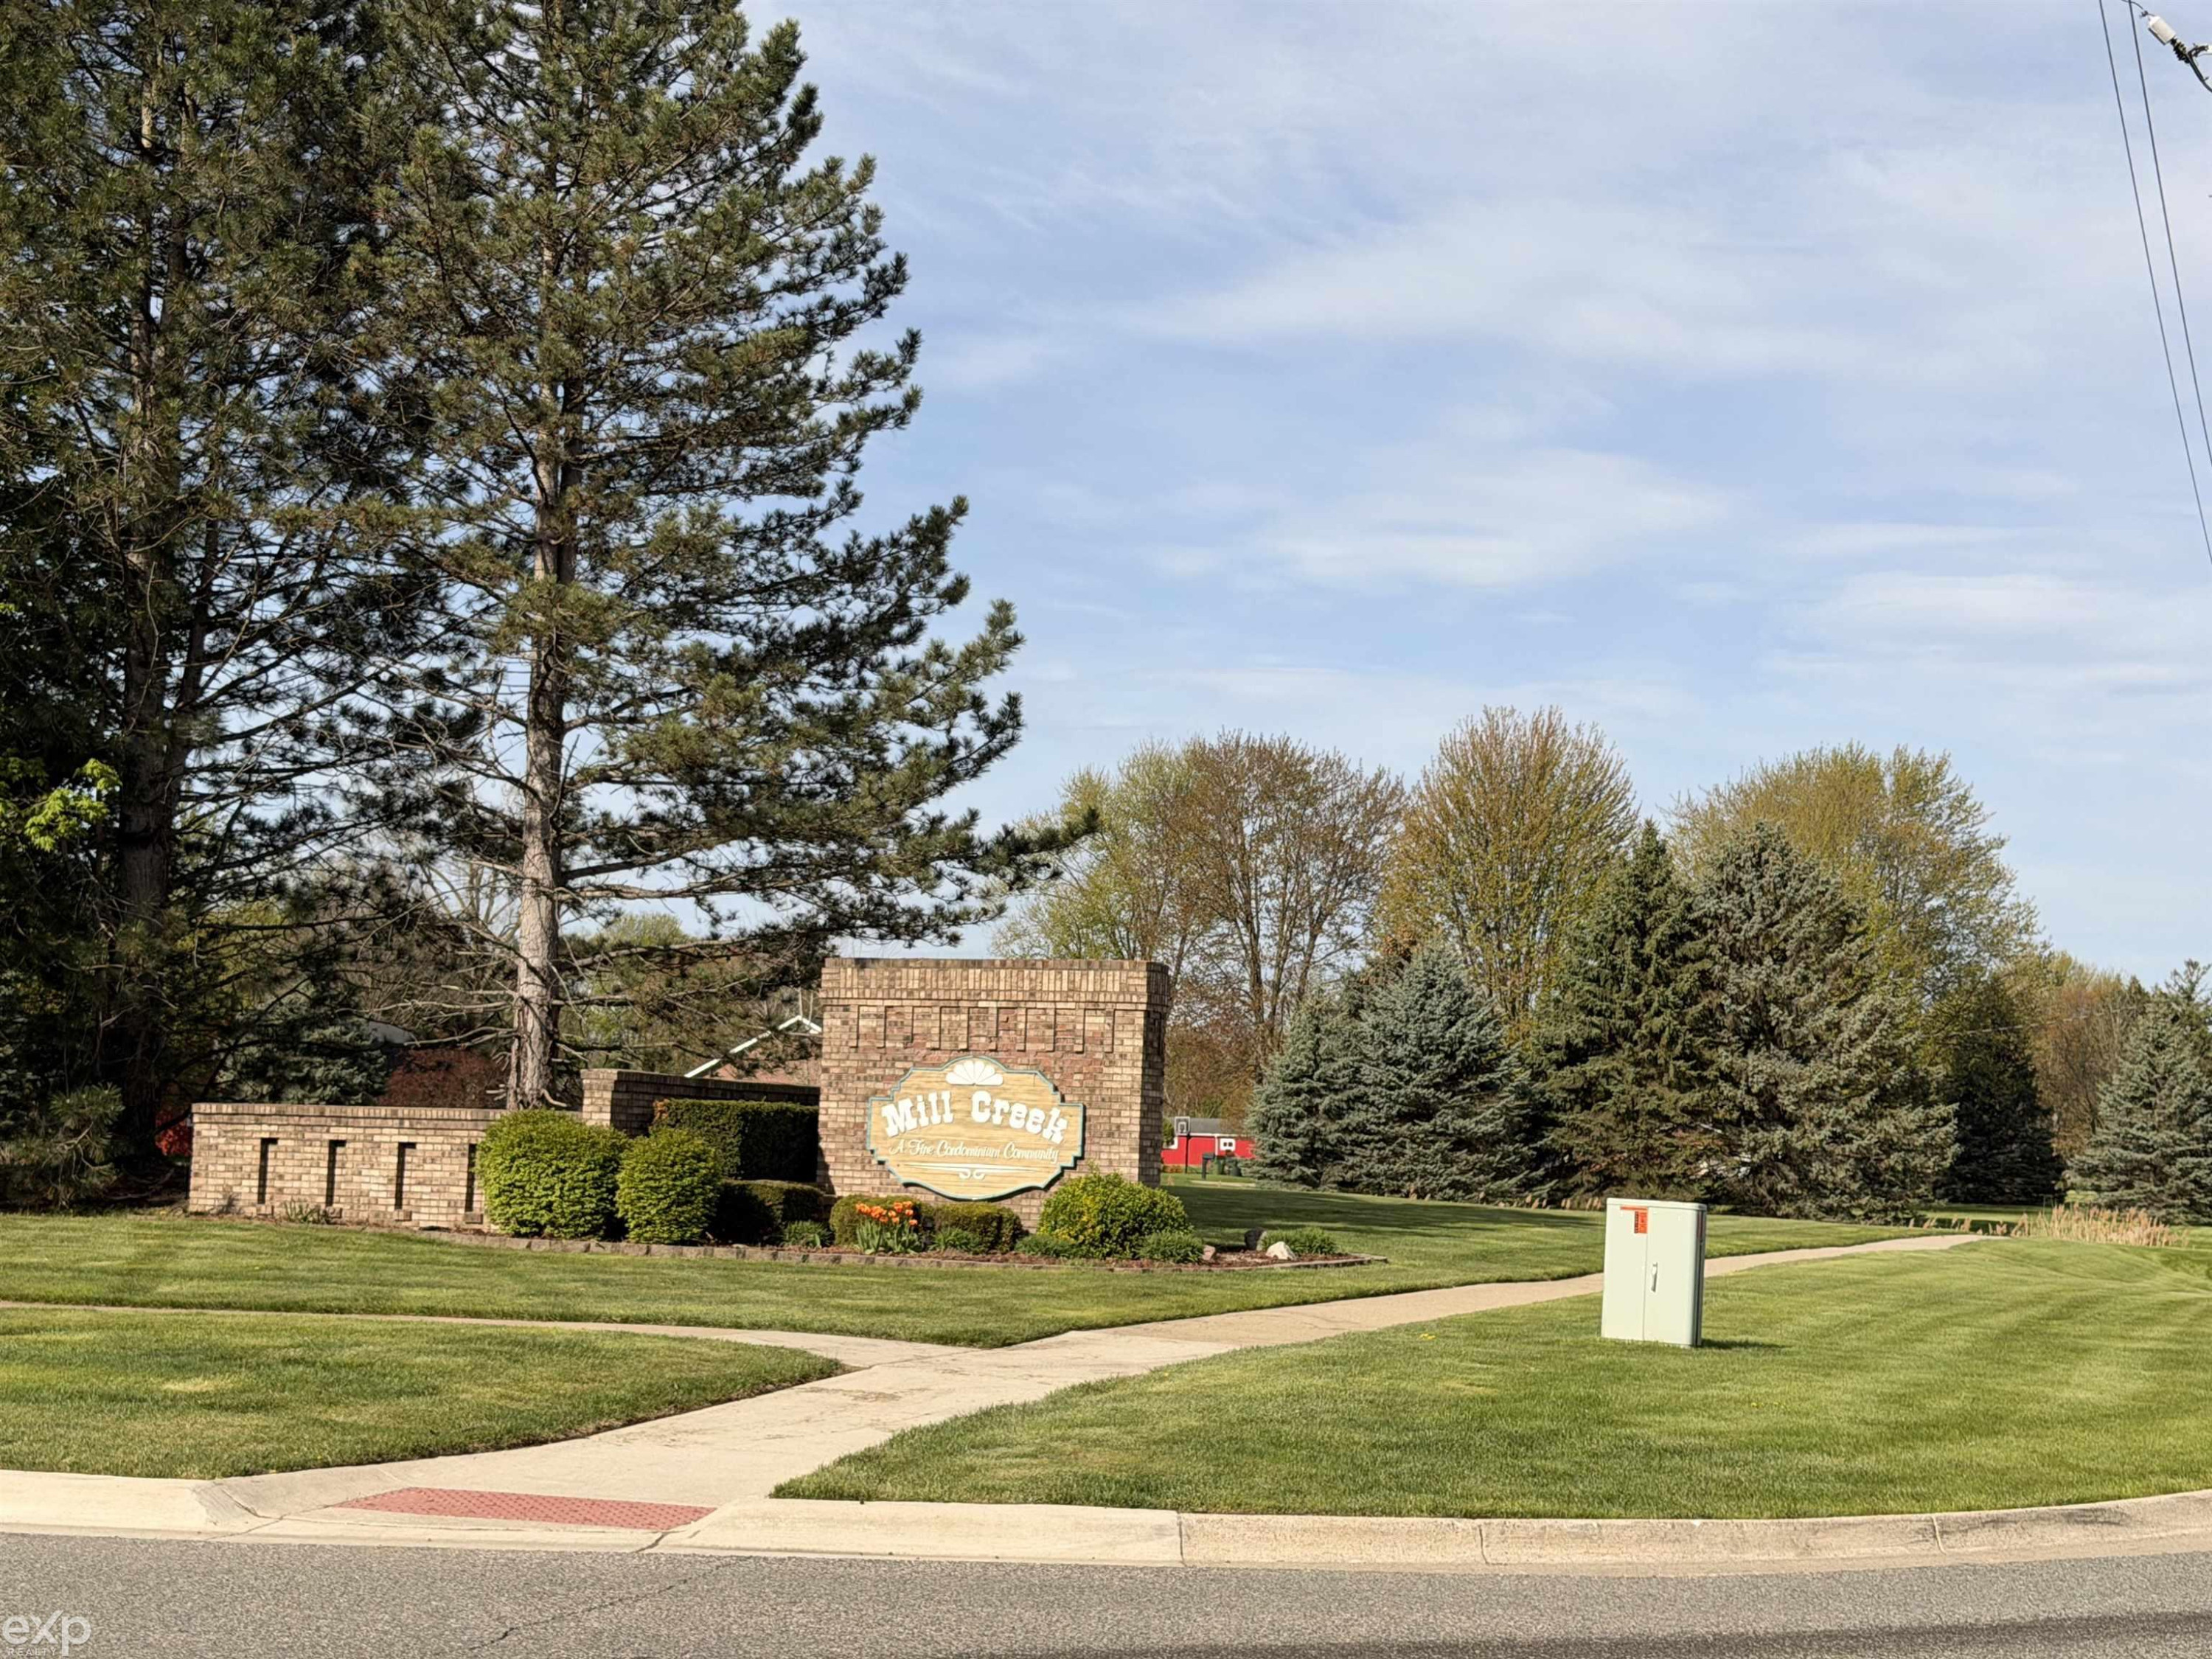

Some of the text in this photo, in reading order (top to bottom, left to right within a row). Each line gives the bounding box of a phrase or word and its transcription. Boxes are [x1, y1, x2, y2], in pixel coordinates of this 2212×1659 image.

[881, 1090, 1068, 1144] Mill Creek
[888, 1138, 1060, 1164] A Fine Condominium Community
